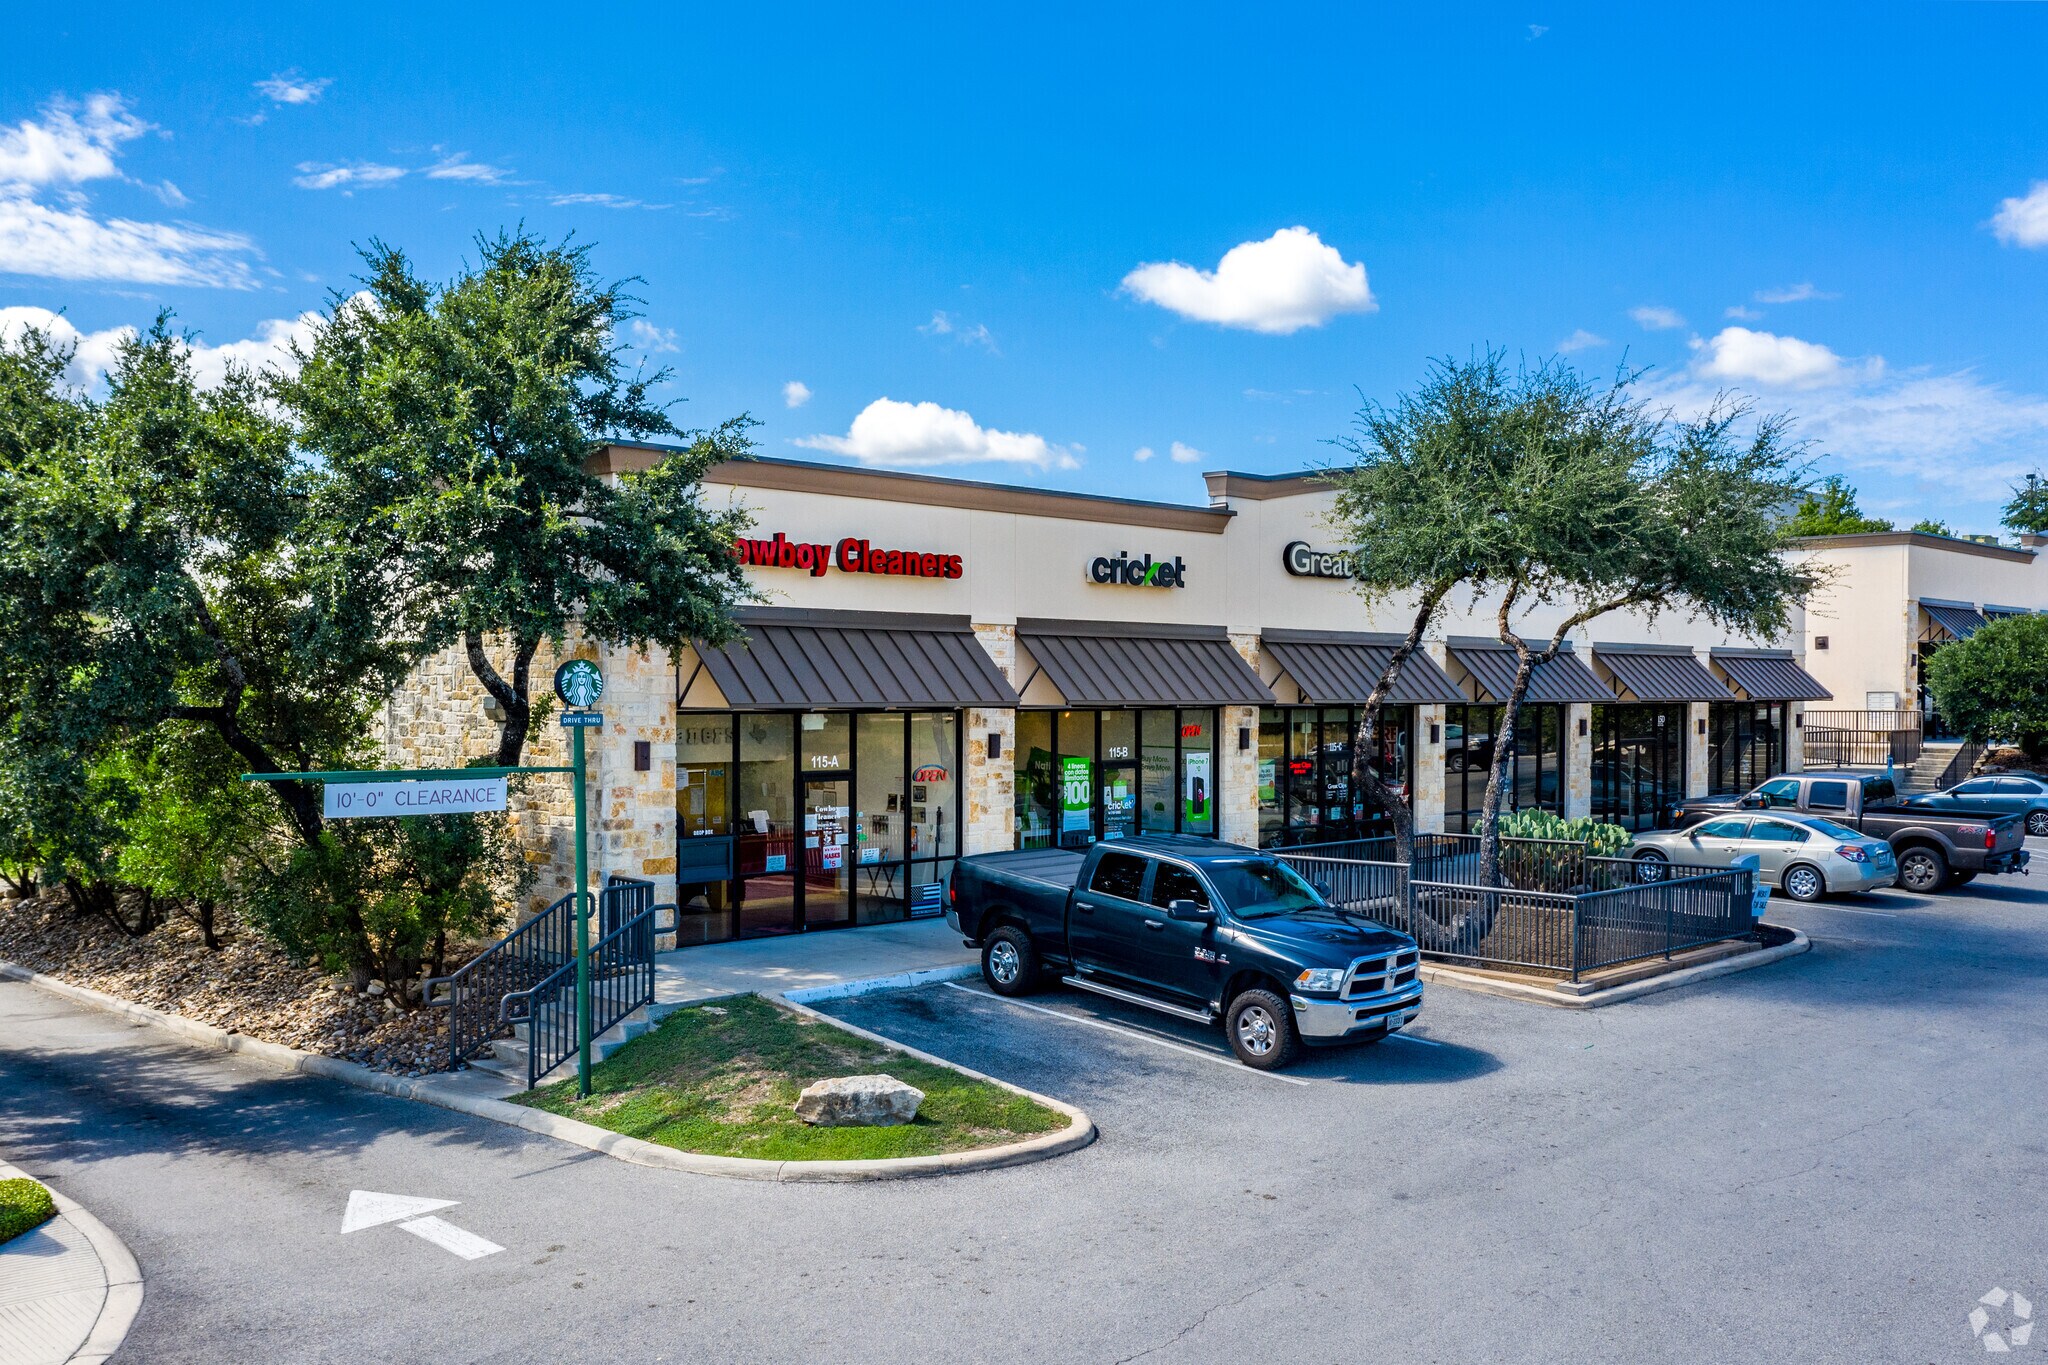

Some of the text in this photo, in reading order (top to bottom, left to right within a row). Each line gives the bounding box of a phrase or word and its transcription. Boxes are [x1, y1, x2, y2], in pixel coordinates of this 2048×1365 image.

[727, 532, 963, 579] owboy Cleaners
[1283, 541, 1354, 579] Great
[1086, 550, 1186, 588] cricket
[1181, 724, 1202, 738] OPEN
[1108, 746, 1129, 758] 115-B
[811, 755, 839, 768] 115-A
[914, 768, 948, 782] OPEN
[337, 787, 497, 808] 10'-0" CLEARANCE
[1063, 780, 1090, 805] $100
[1107, 800, 1134, 810] cricket
